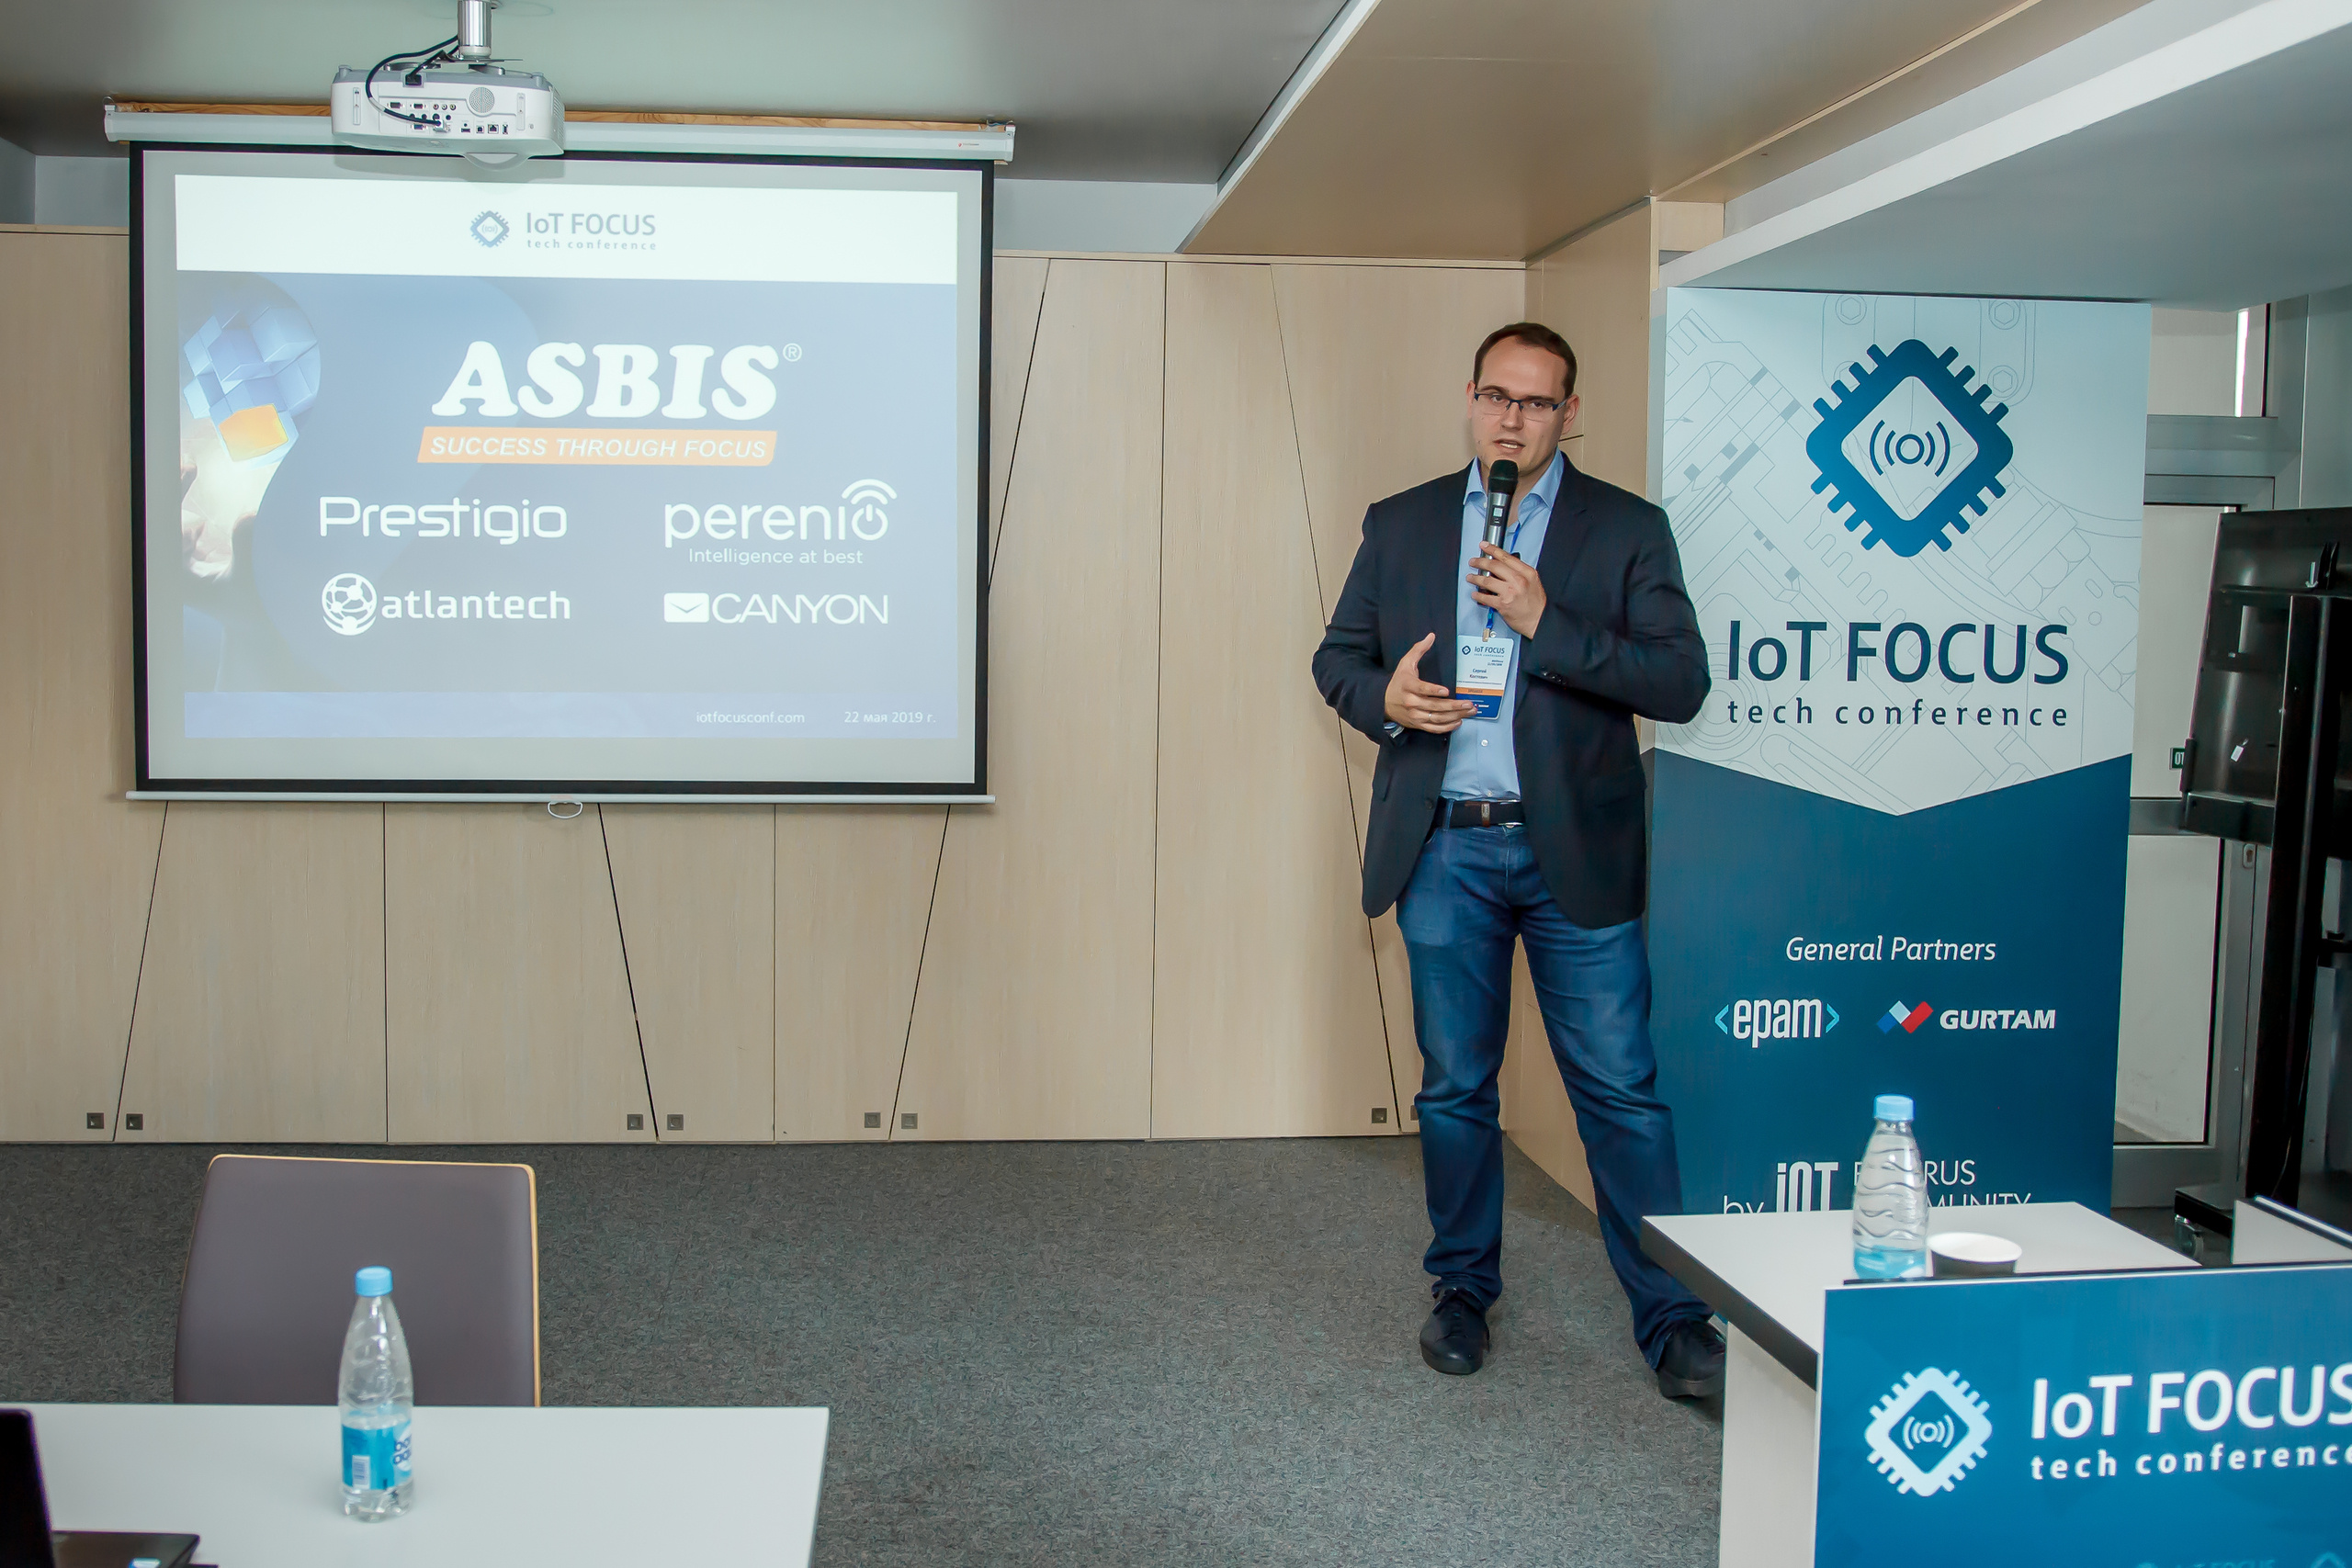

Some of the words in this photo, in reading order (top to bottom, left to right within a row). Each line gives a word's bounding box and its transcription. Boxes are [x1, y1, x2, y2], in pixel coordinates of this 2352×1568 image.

[526, 212, 564, 234] IoT
[571, 213, 656, 236] FOCUS
[527, 239, 560, 249] tech
[568, 239, 656, 251] conference
[431, 341, 780, 421] ASBIS
[430, 436, 548, 457] SUCCESS
[556, 438, 677, 458] THROUGH
[683, 440, 768, 459] FOCUS
[320, 496, 568, 545] Prestigio
[664, 502, 889, 548] perenio
[689, 548, 794, 565] Intelligence
[799, 549, 818, 563] at
[823, 549, 864, 564] best
[381, 590, 571, 619] atlantech
[712, 593, 888, 625] CANYON
[1728, 620, 1827, 682] IoT
[1847, 622, 2069, 684] FOCUS
[695, 711, 805, 724] iotfocusconf.com
[843, 712, 859, 723] 22
[863, 714, 888, 723] мая
[891, 712, 923, 723] 2019
[1727, 697, 1813, 724] tech
[1835, 699, 2067, 726] conference
[1786, 935, 1883, 961] General
[1891, 936, 1996, 961] Partners
[1939, 1009, 2056, 1030] GURTAM
[2031, 1374, 2133, 1438] IoT
[2147, 1363, 2352, 1433] FOCUS
[2030, 1449, 2118, 1480] tech
